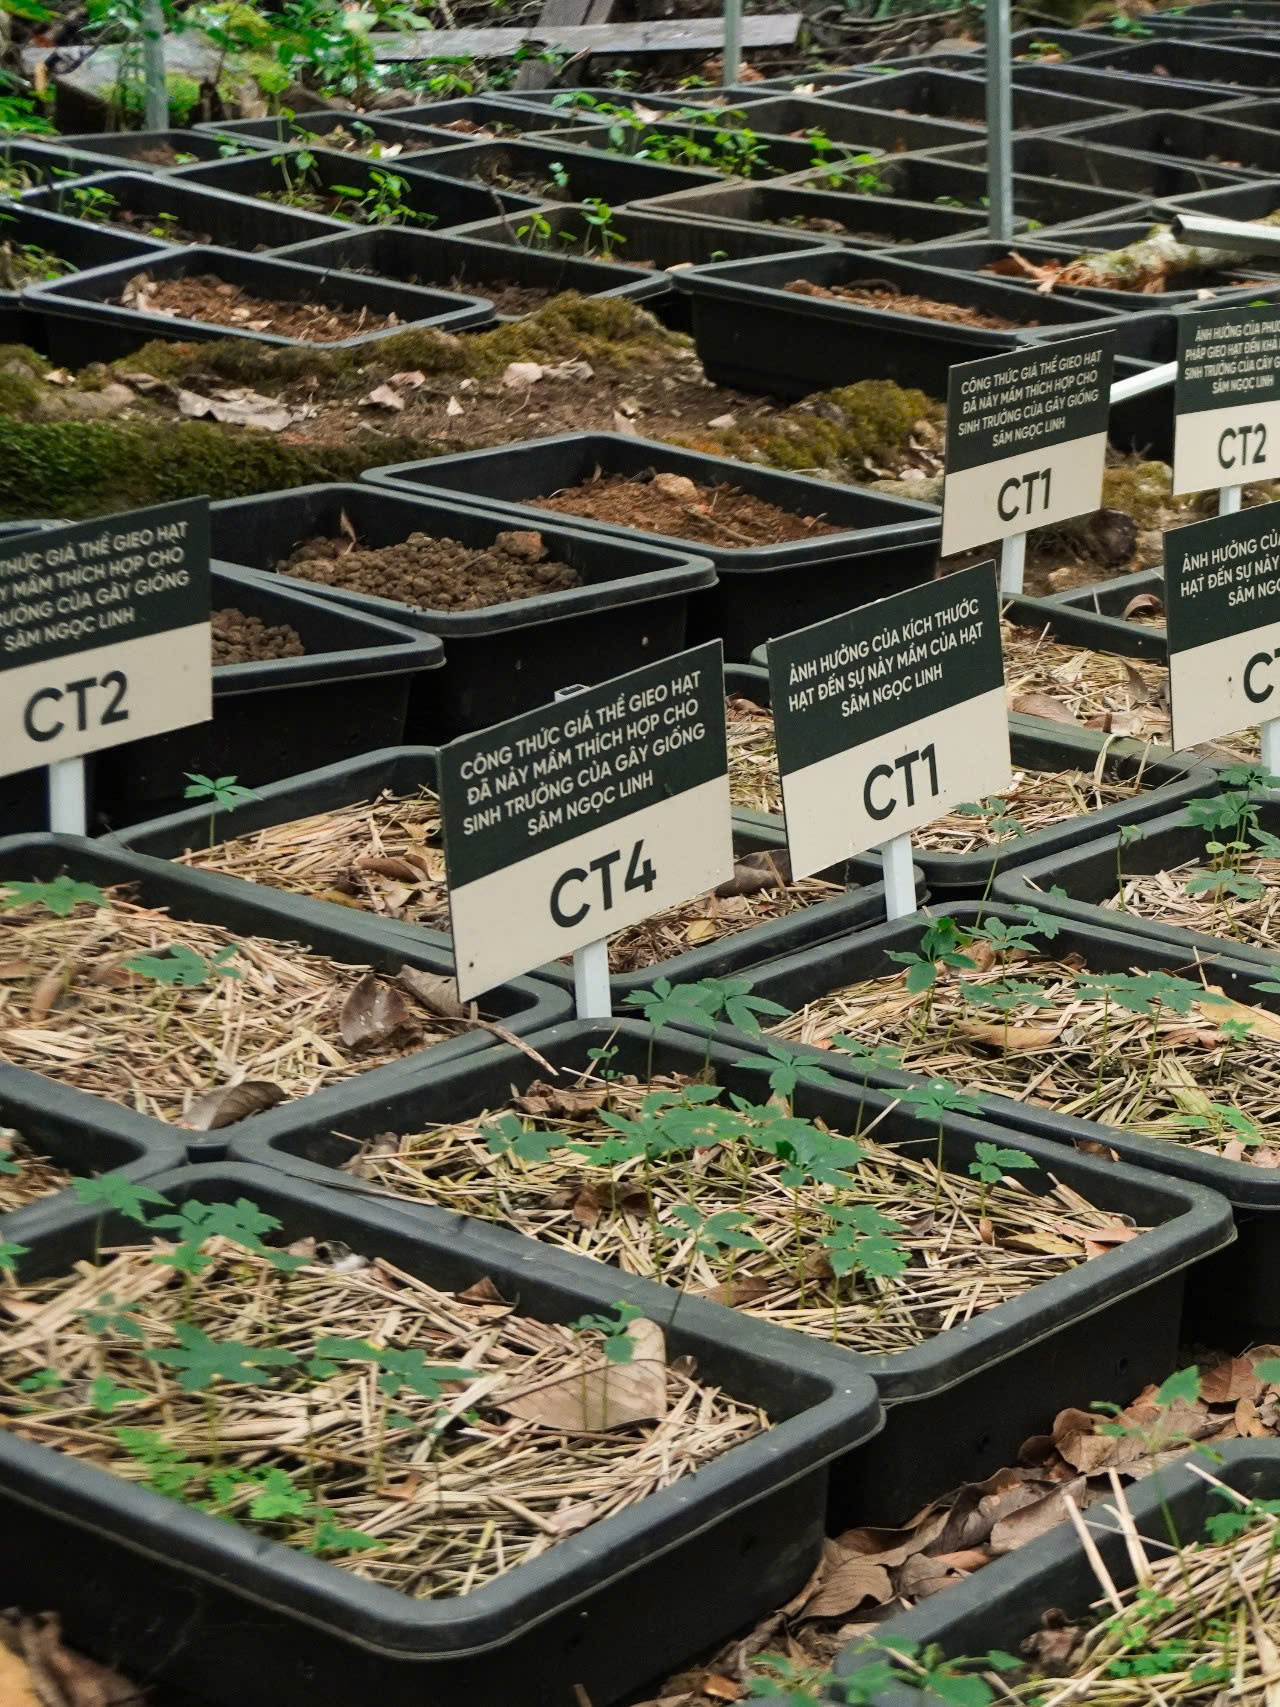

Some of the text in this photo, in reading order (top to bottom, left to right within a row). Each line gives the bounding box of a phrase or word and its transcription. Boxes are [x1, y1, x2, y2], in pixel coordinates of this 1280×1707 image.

[961, 377, 991, 395] CÔNG
[993, 368, 1018, 386] THỨC
[1021, 362, 1037, 380] GIÁ
[1059, 355, 1082, 370] GIEO
[1083, 350, 1102, 367] HẠT
[963, 397, 977, 415] ĐÃ
[1025, 379, 1052, 397] THÍCH
[1054, 376, 1075, 394] HỢP
[1076, 370, 1098, 385] CHO
[1185, 367, 1203, 380] SINH
[1256, 375, 1274, 388] LINH
[958, 420, 980, 437] SINH
[1023, 401, 1043, 419] CỦA
[1067, 388, 1099, 408] GIỐNG
[992, 417, 1065, 447] SÂM NGỌC LINH
[1218, 423, 1266, 469] CT2
[998, 467, 1051, 521] CT1
[79, 531, 110, 558] THỂ
[113, 529, 154, 551] GIEO
[157, 521, 189, 544] HẠT
[1182, 553, 1209, 573] ẢNH
[1211, 539, 1257, 565] HƯỞNG
[55, 563, 105, 589] THÍCH
[109, 555, 145, 578] HỢP
[147, 546, 185, 569] CHO
[1180, 577, 1204, 599] HẠT
[1208, 565, 1233, 589] ĐẾN
[1236, 562, 1252, 583] SỰ
[1255, 553, 1279, 576] NẢY
[57, 589, 93, 613] CỦA
[1228, 586, 1255, 607] SÂM
[4, 606, 135, 652] SÂM NGỌC LINH
[789, 598, 979, 686] ẢNH HƯỞNG CỦA KÍCH THƯỚC
[788, 622, 983, 712] HẠT ĐẾN SỰ NẢY MẦM CỦA HẠT
[841, 663, 943, 717] SÂM NGỌC LINH
[24, 670, 129, 742] CT2
[461, 670, 701, 780] CÔNG THỨC GIÁ THỂ GIEO HẠT
[466, 698, 699, 806] ĐÃ NẢY MẦM THÍCH HỢP CHO
[463, 722, 706, 836] SINH TRƯỞNG CỦA GÂY GIỐNG
[864, 743, 938, 820] CT1
[527, 770, 653, 836] SÂM NGỌC LINH
[550, 839, 656, 928] CT4
